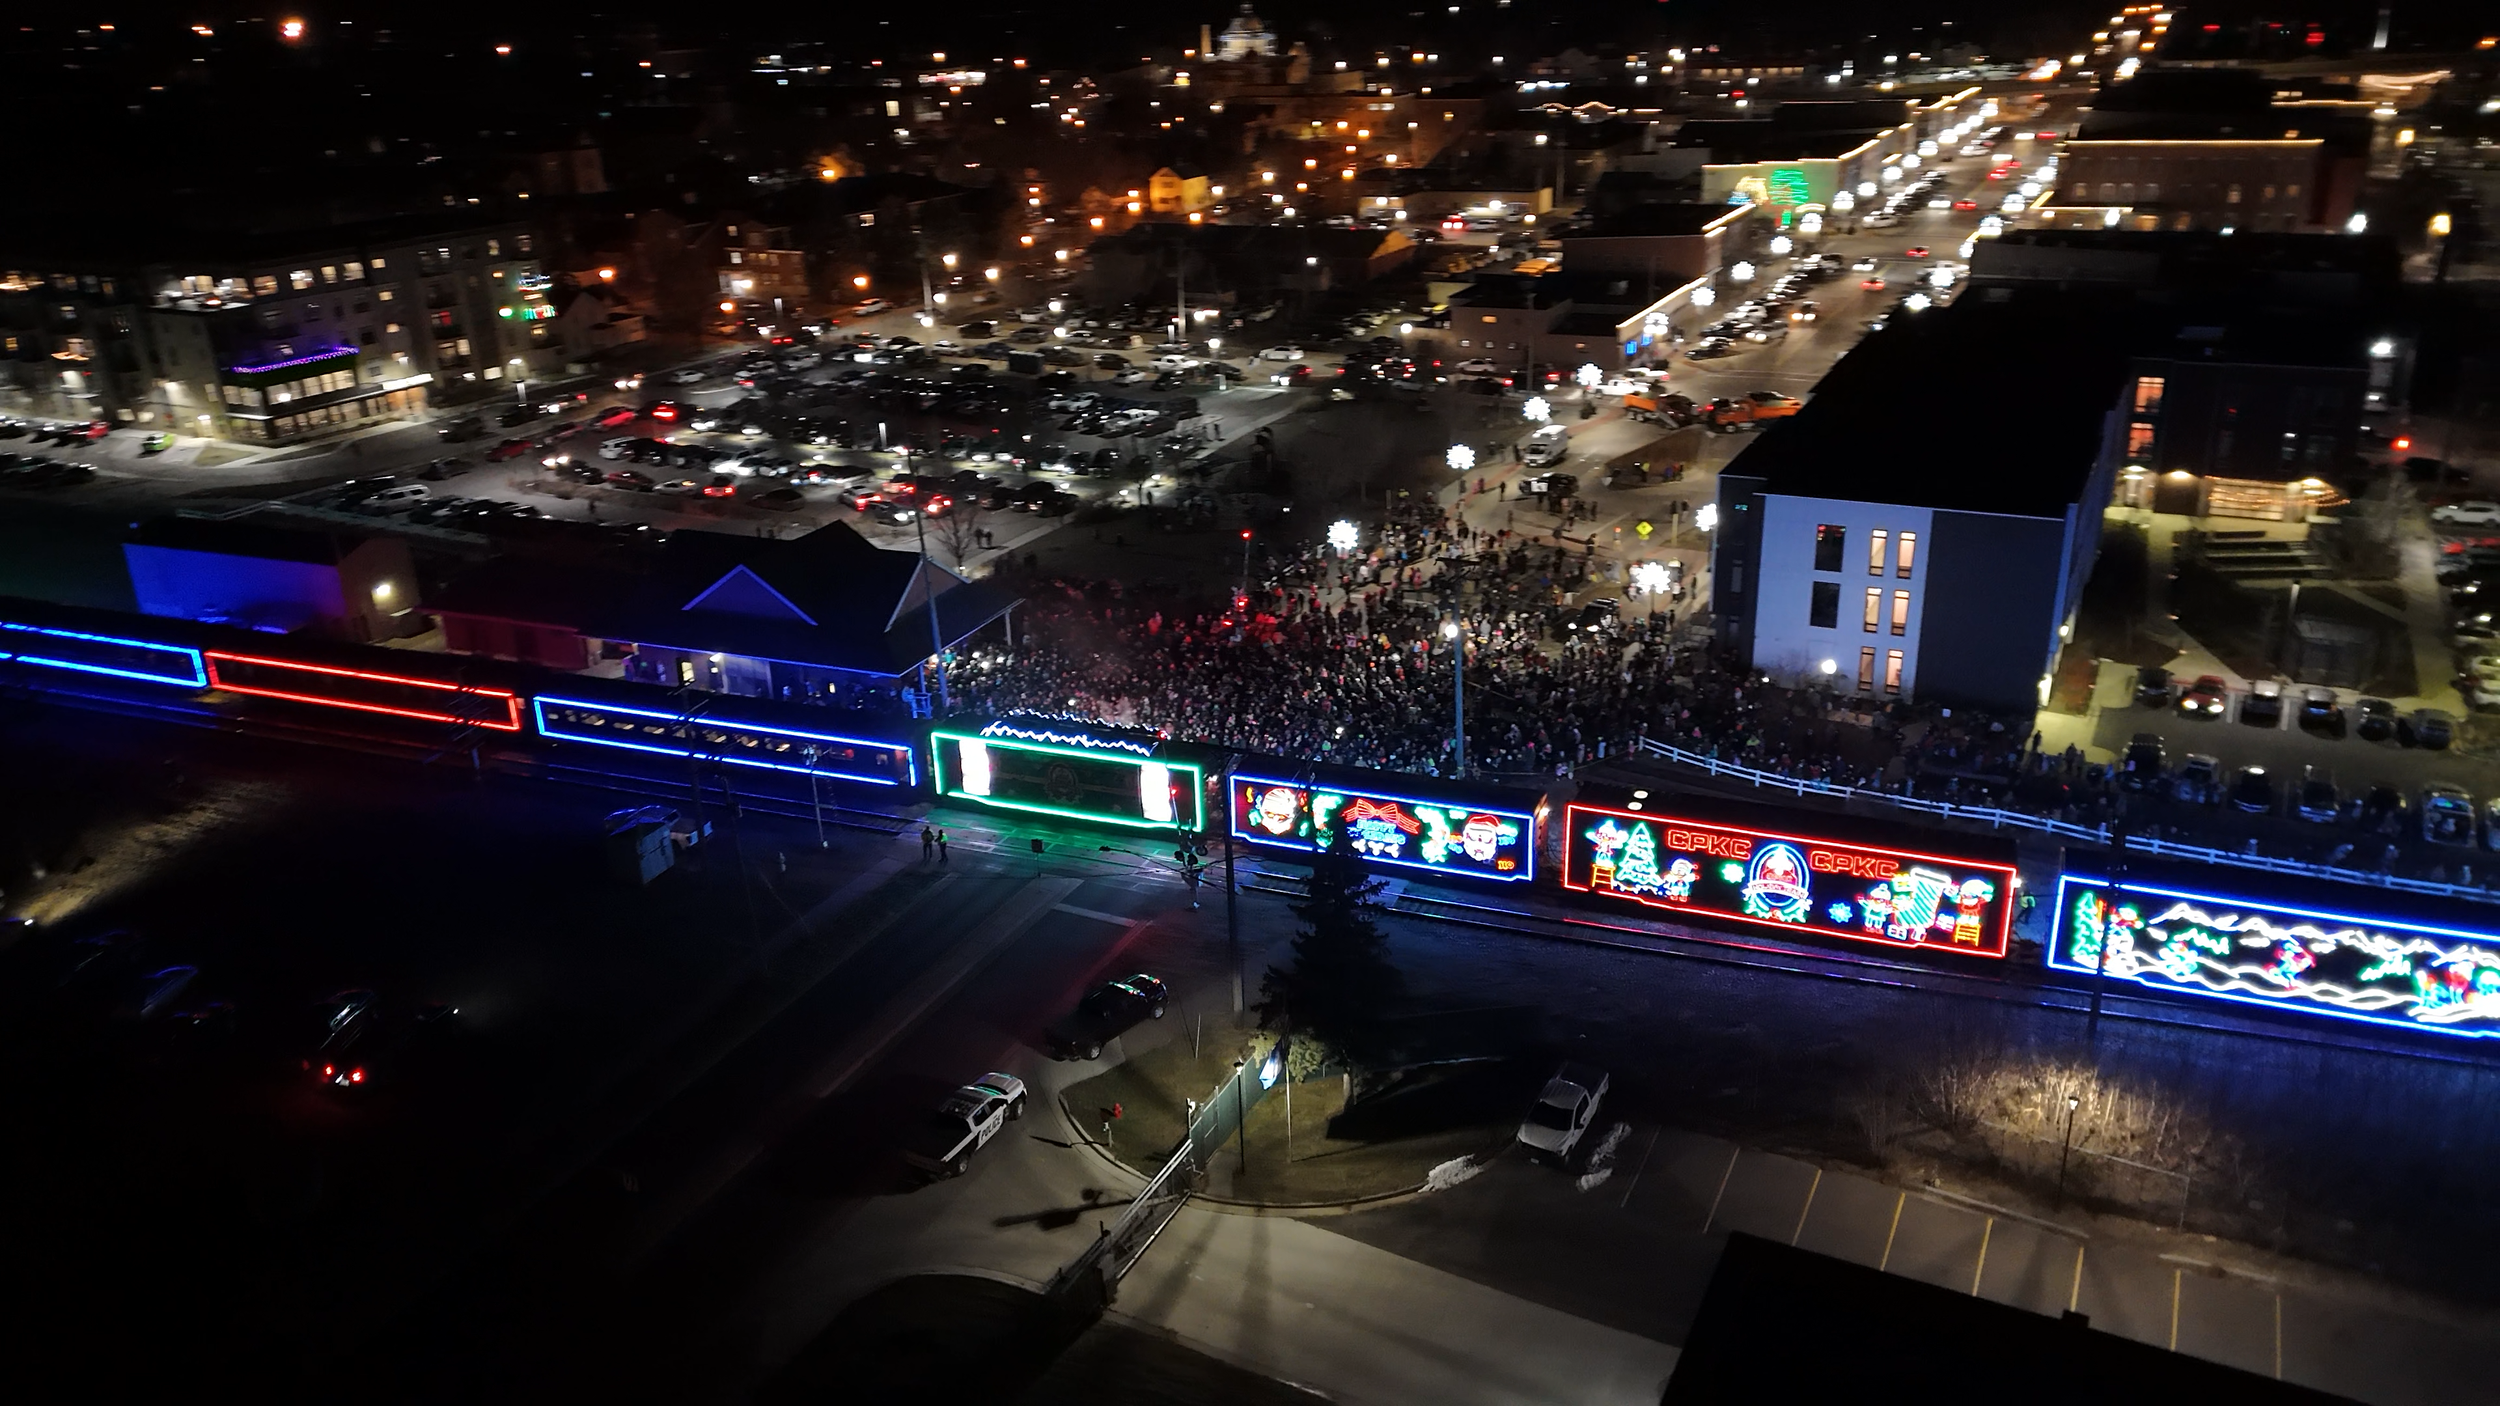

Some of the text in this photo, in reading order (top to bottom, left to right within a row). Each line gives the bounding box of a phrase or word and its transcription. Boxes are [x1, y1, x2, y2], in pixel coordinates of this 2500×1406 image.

[1668, 829, 1752, 860] CPKC
[1810, 850, 1899, 881] CPKC
[981, 1114, 1001, 1140] POLICE
